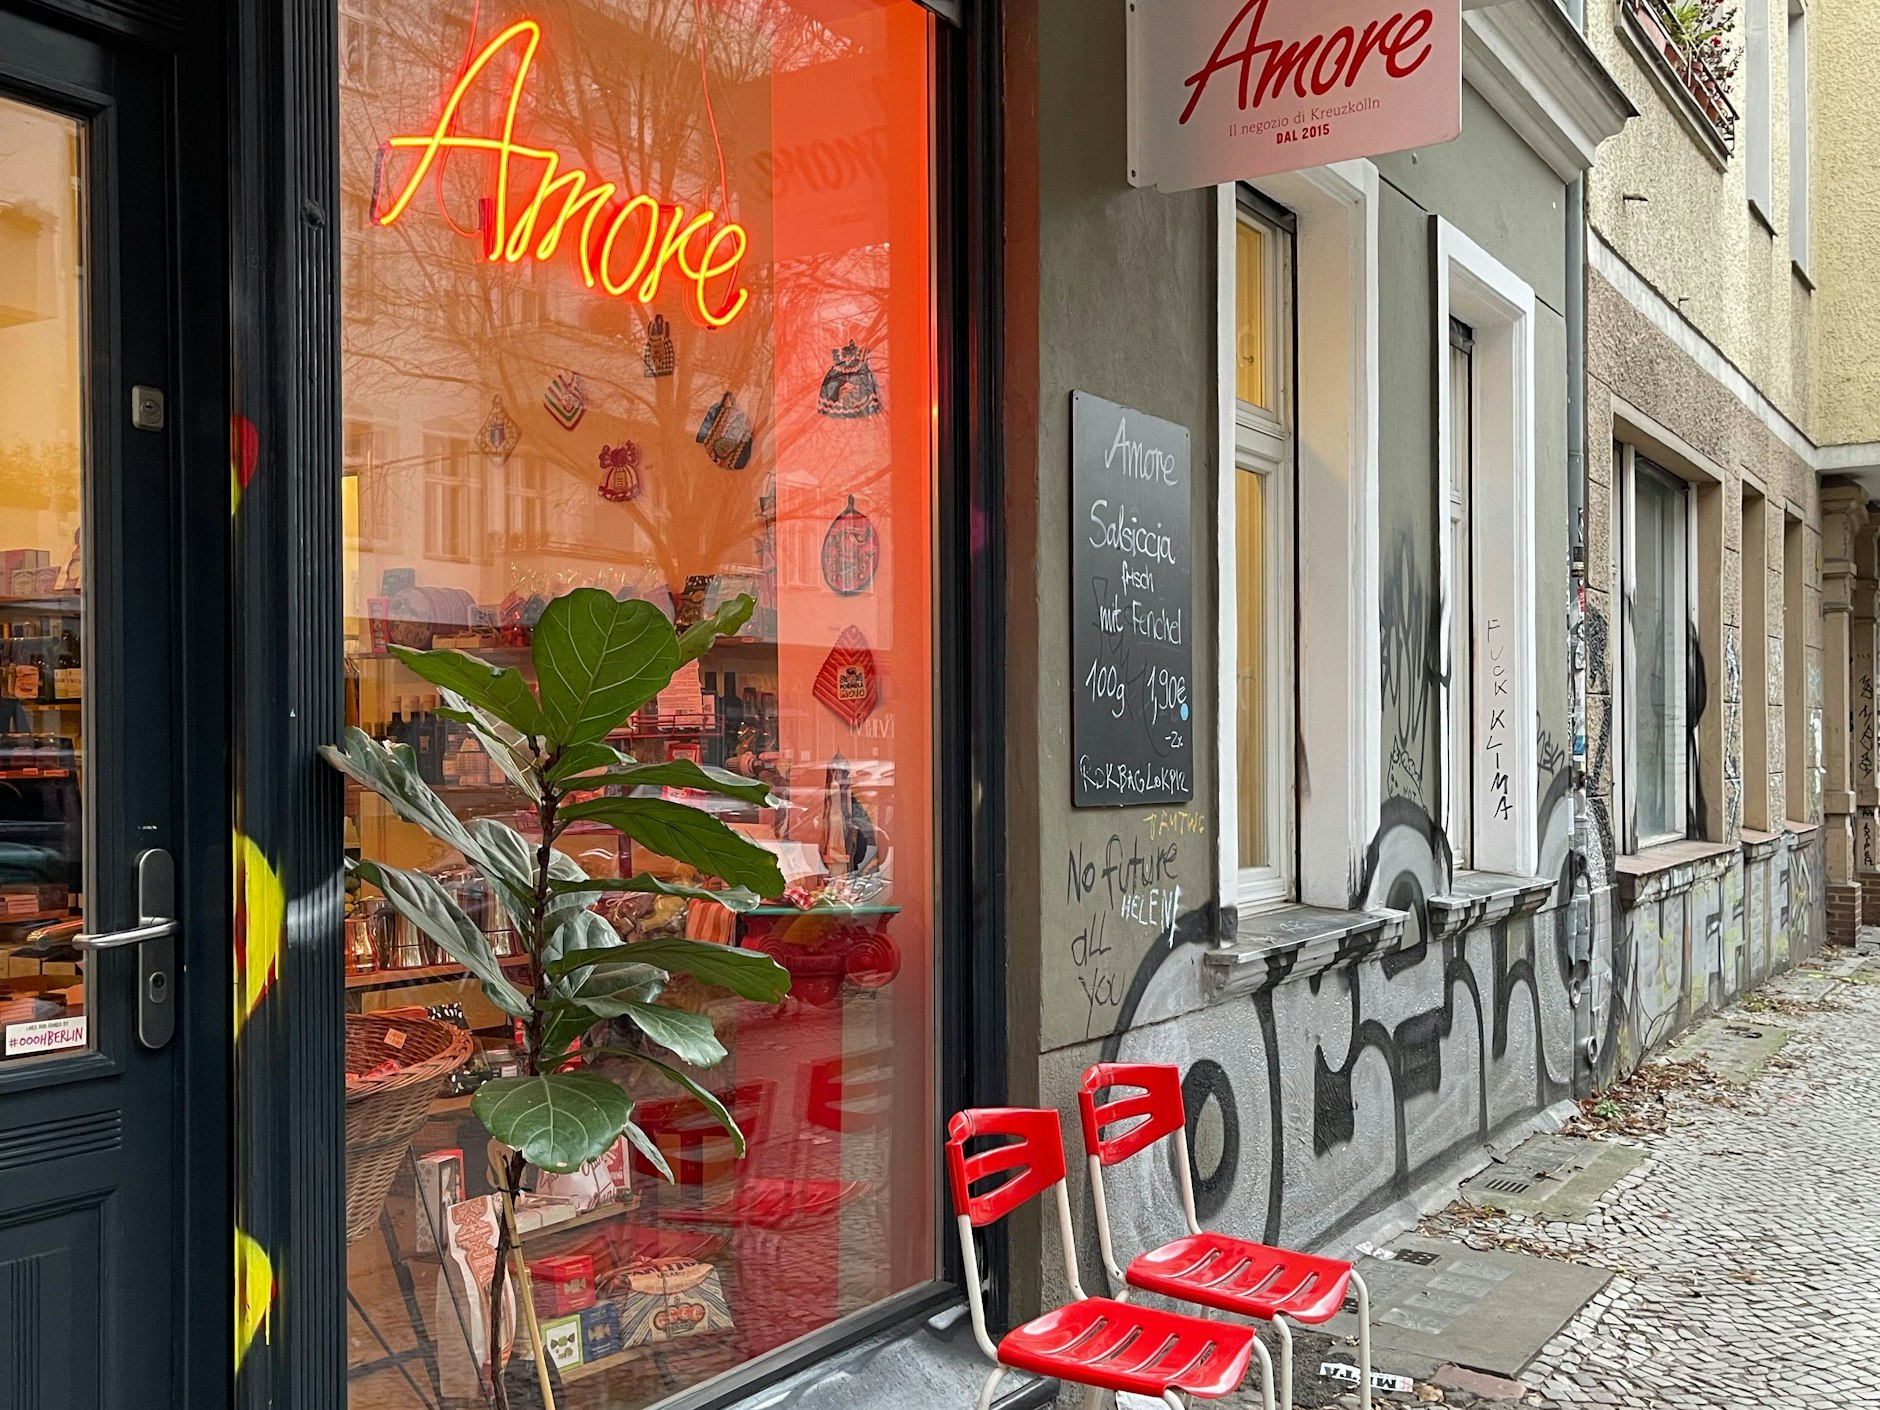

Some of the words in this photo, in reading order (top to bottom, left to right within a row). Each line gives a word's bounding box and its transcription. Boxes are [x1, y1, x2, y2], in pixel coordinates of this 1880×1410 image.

[1178, 0, 1433, 125] Amore
[1229, 124, 1237, 137] Il
[1241, 115, 1289, 136] negozio
[1294, 111, 1306, 124] di
[1276, 128, 1299, 144] DAL
[1302, 123, 1331, 140] 2015
[376, 18, 749, 326] Amore
[1104, 415, 1179, 487] Amore
[1089, 499, 1176, 565] Salsiccia
[1121, 560, 1155, 597] frisch
[1099, 593, 1124, 633] mit
[1132, 600, 1183, 645] Fenchel
[1486, 618, 1508, 697] FUCK
[1085, 658, 1126, 719] 100g
[1146, 665, 1188, 726] 1,90€
[1066, 841, 1097, 905] No
[1101, 834, 1179, 910] future
